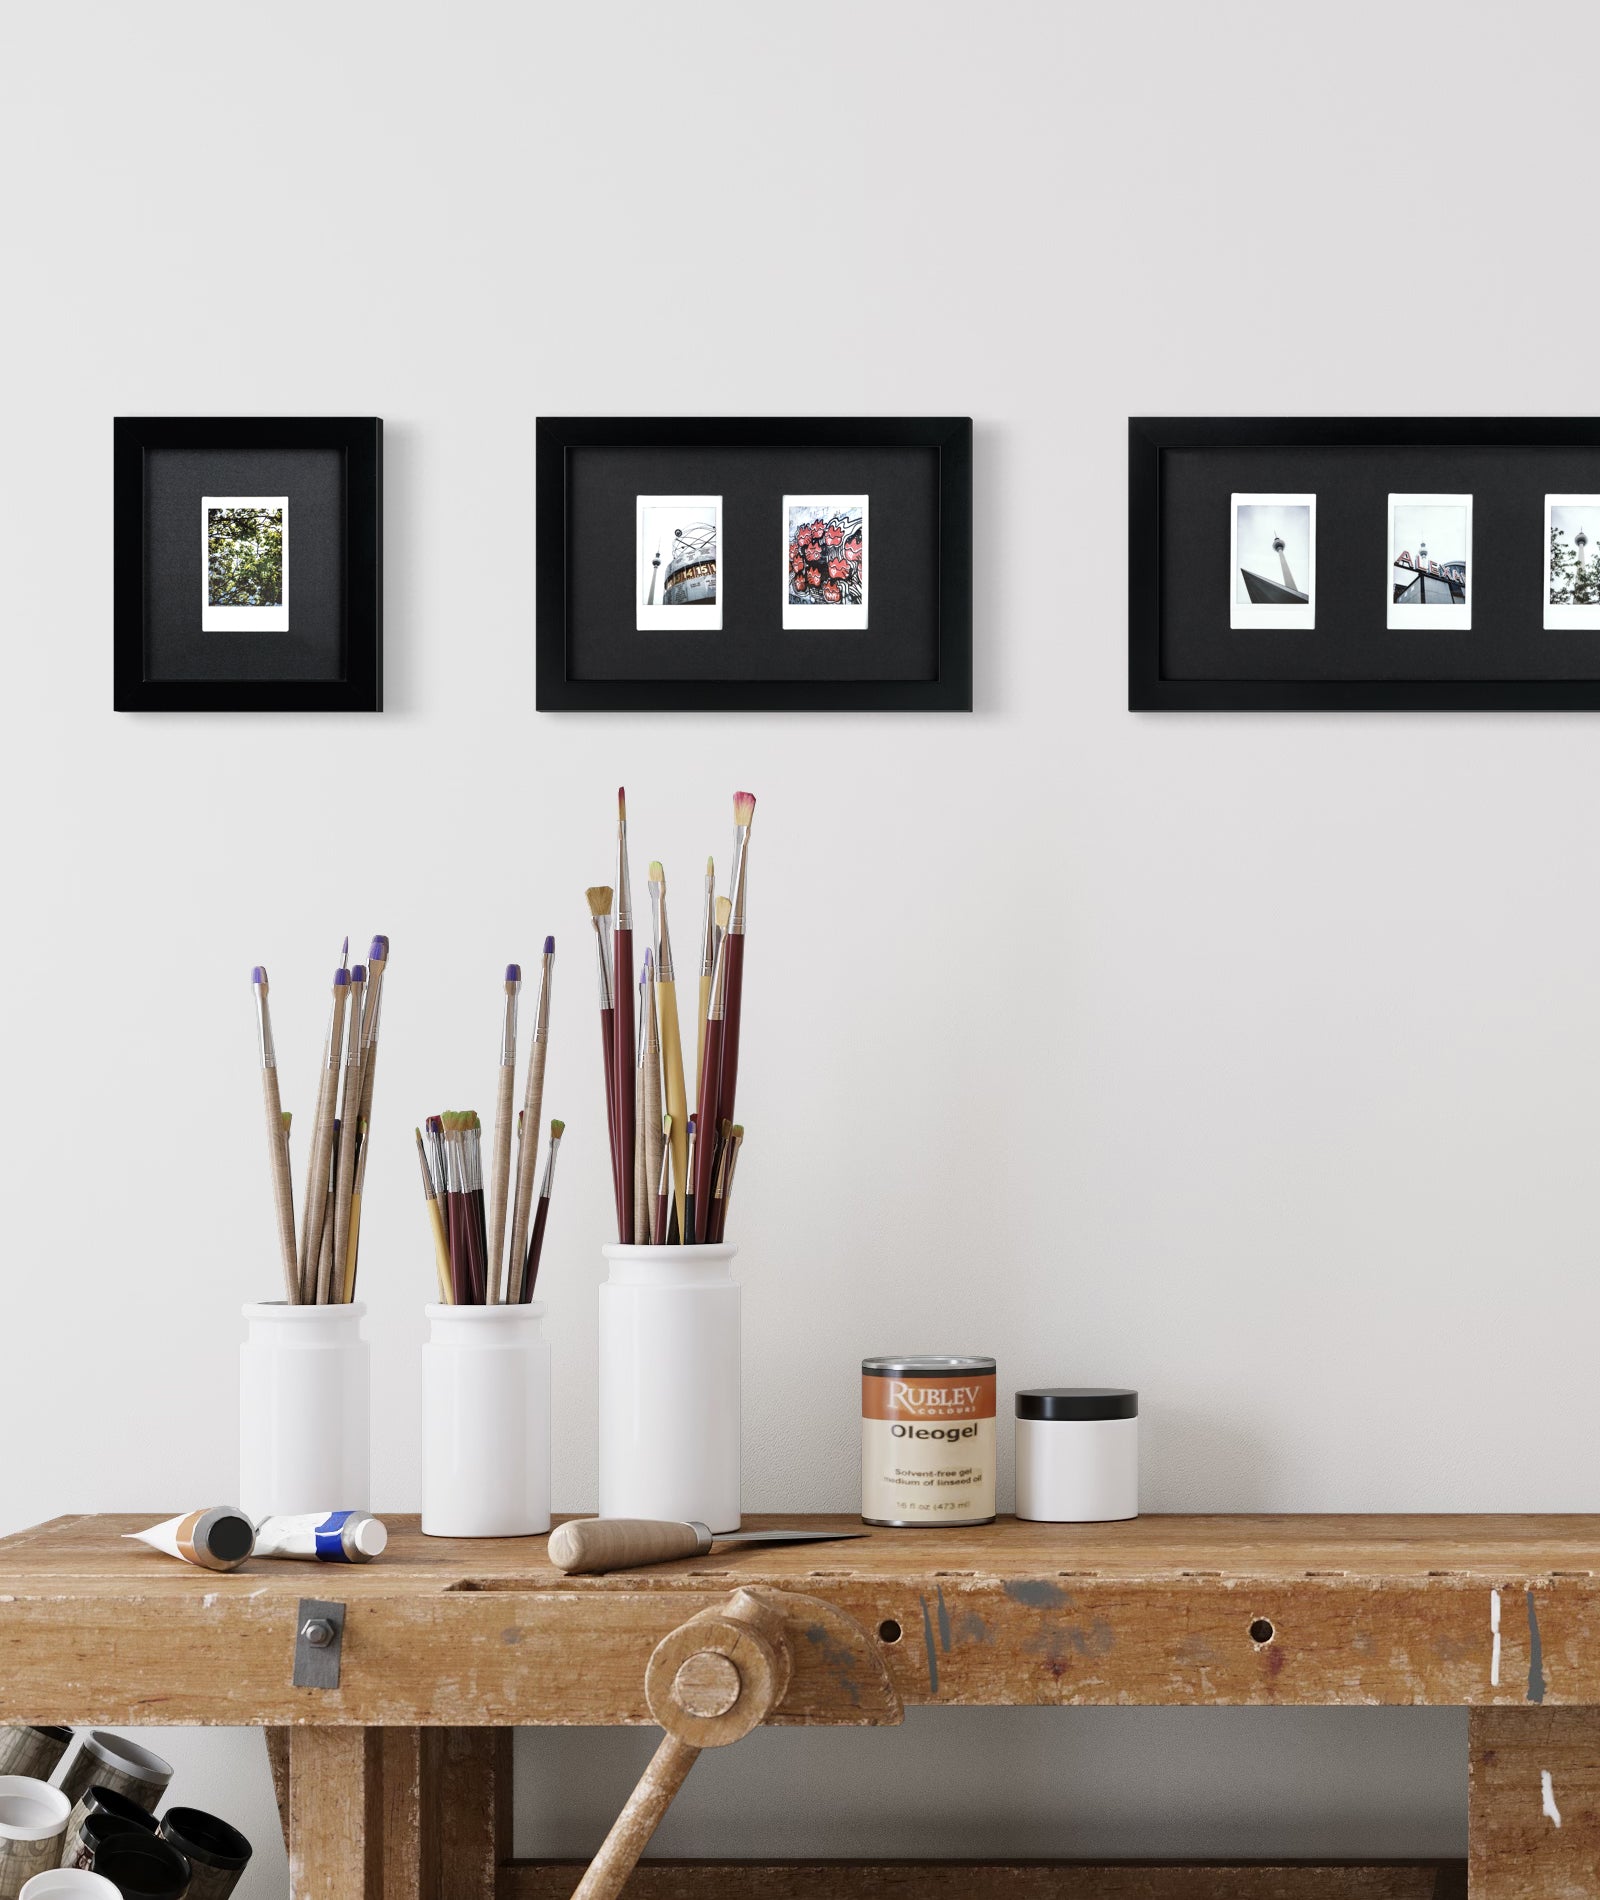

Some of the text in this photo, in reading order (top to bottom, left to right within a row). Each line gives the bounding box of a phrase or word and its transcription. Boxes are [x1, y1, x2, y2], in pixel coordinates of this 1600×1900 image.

[696, 565, 708, 574] 15
[887, 1380, 980, 1414] RUBLEV
[891, 1423, 978, 1442] Oleogel
[895, 1468, 972, 1477] Solvent-free gel
[937, 1477, 972, 1486] linseed
[973, 1474, 982, 1482] oil
